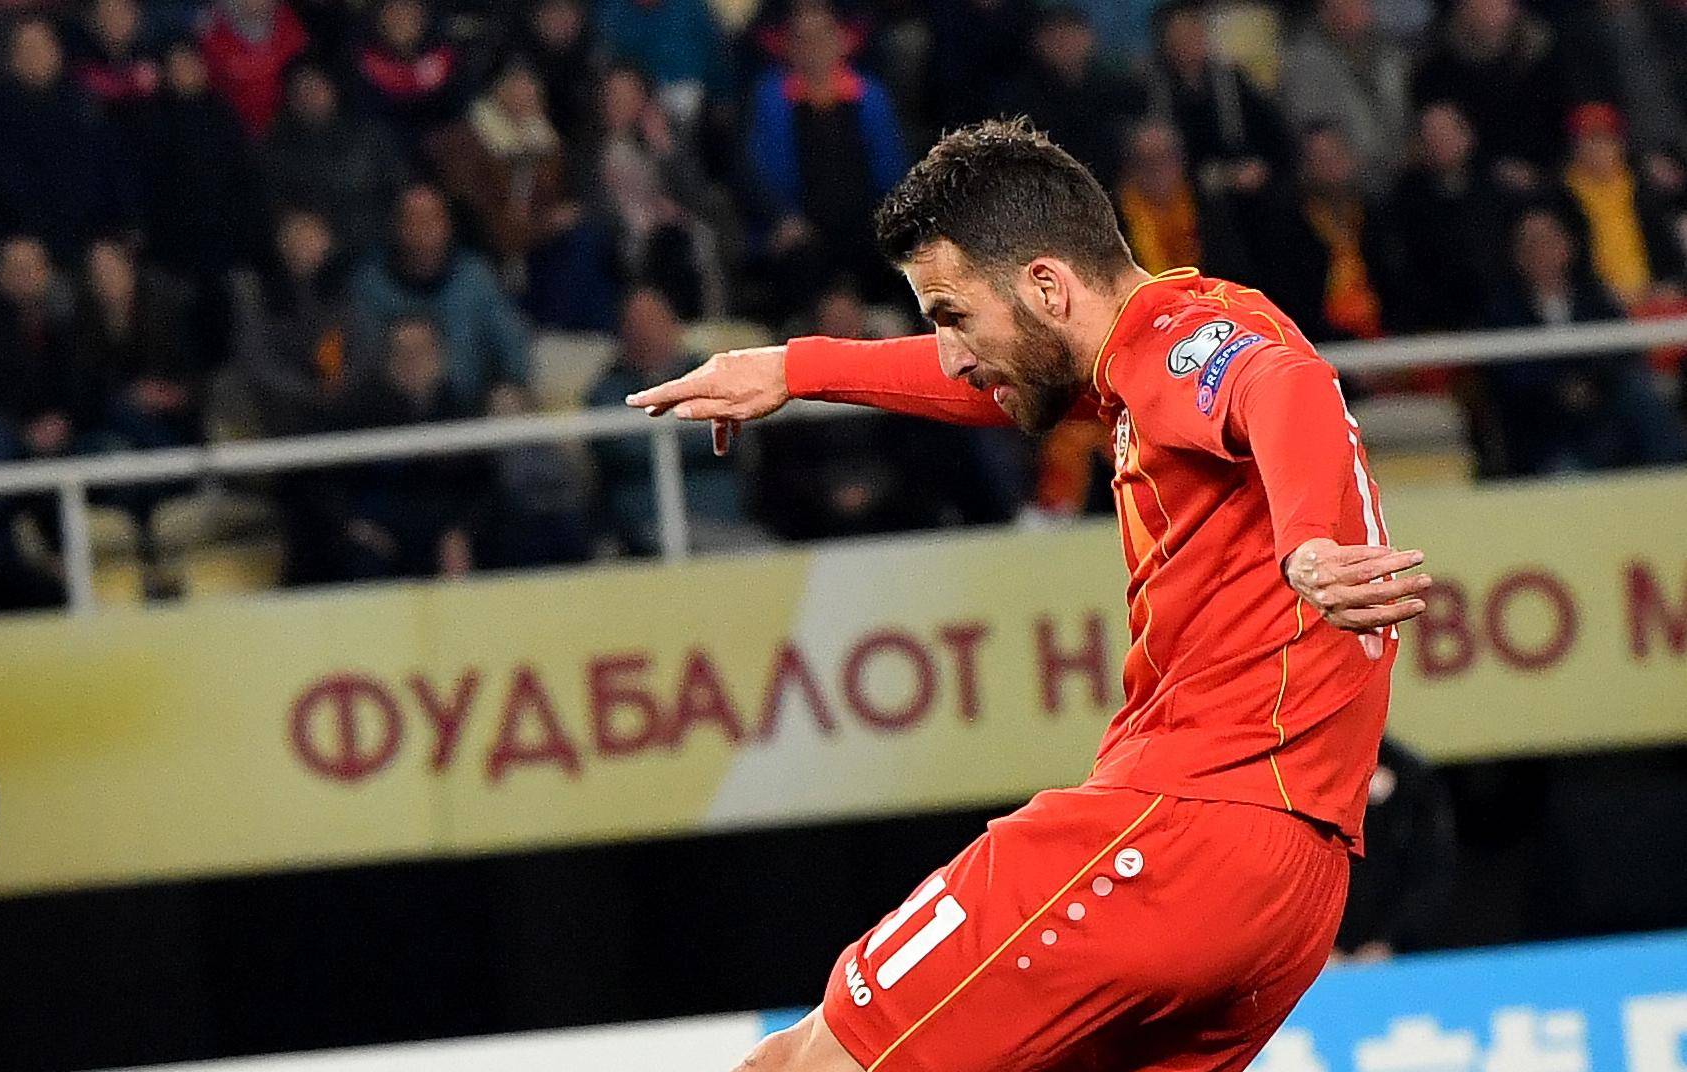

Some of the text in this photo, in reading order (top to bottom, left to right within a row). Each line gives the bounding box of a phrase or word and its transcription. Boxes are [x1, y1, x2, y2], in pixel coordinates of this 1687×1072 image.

[287, 616, 993, 786] ФУДБАЛОТ
[1031, 608, 1119, 716] Н
[1417, 568, 1583, 684] ВО
[862, 873, 968, 990] 11
